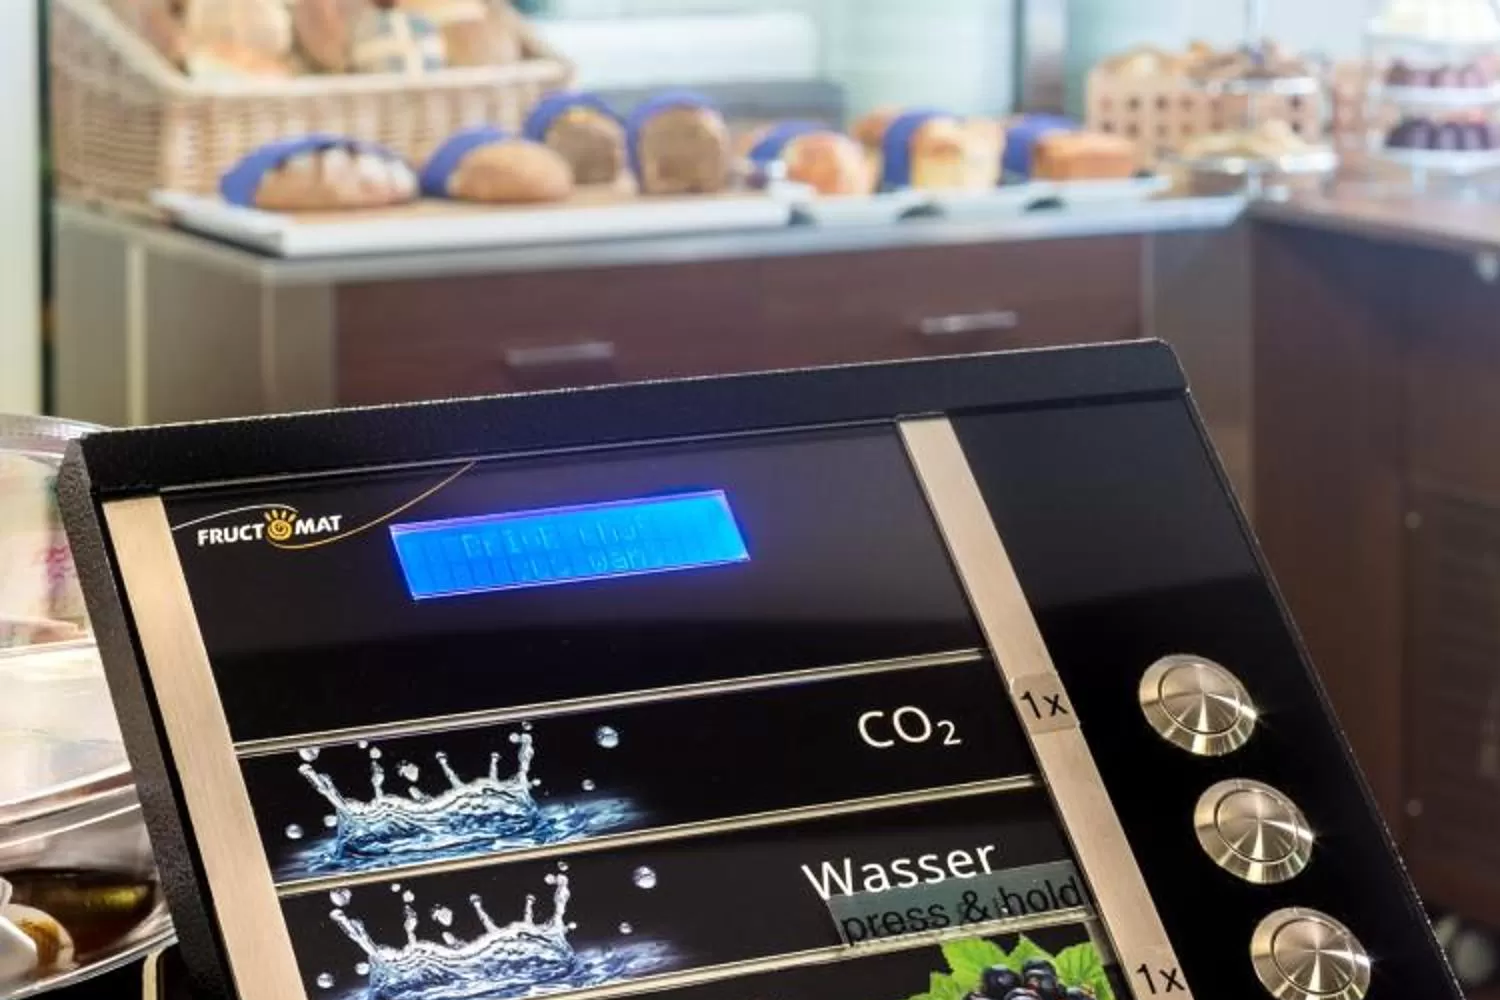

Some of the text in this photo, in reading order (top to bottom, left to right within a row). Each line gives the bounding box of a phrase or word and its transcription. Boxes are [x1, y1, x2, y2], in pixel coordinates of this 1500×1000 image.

[1019, 690, 1069, 720] 1x
[801, 843, 996, 901] Wasser
[839, 874, 1082, 945] press & hold
[1136, 963, 1186, 996] 1x
